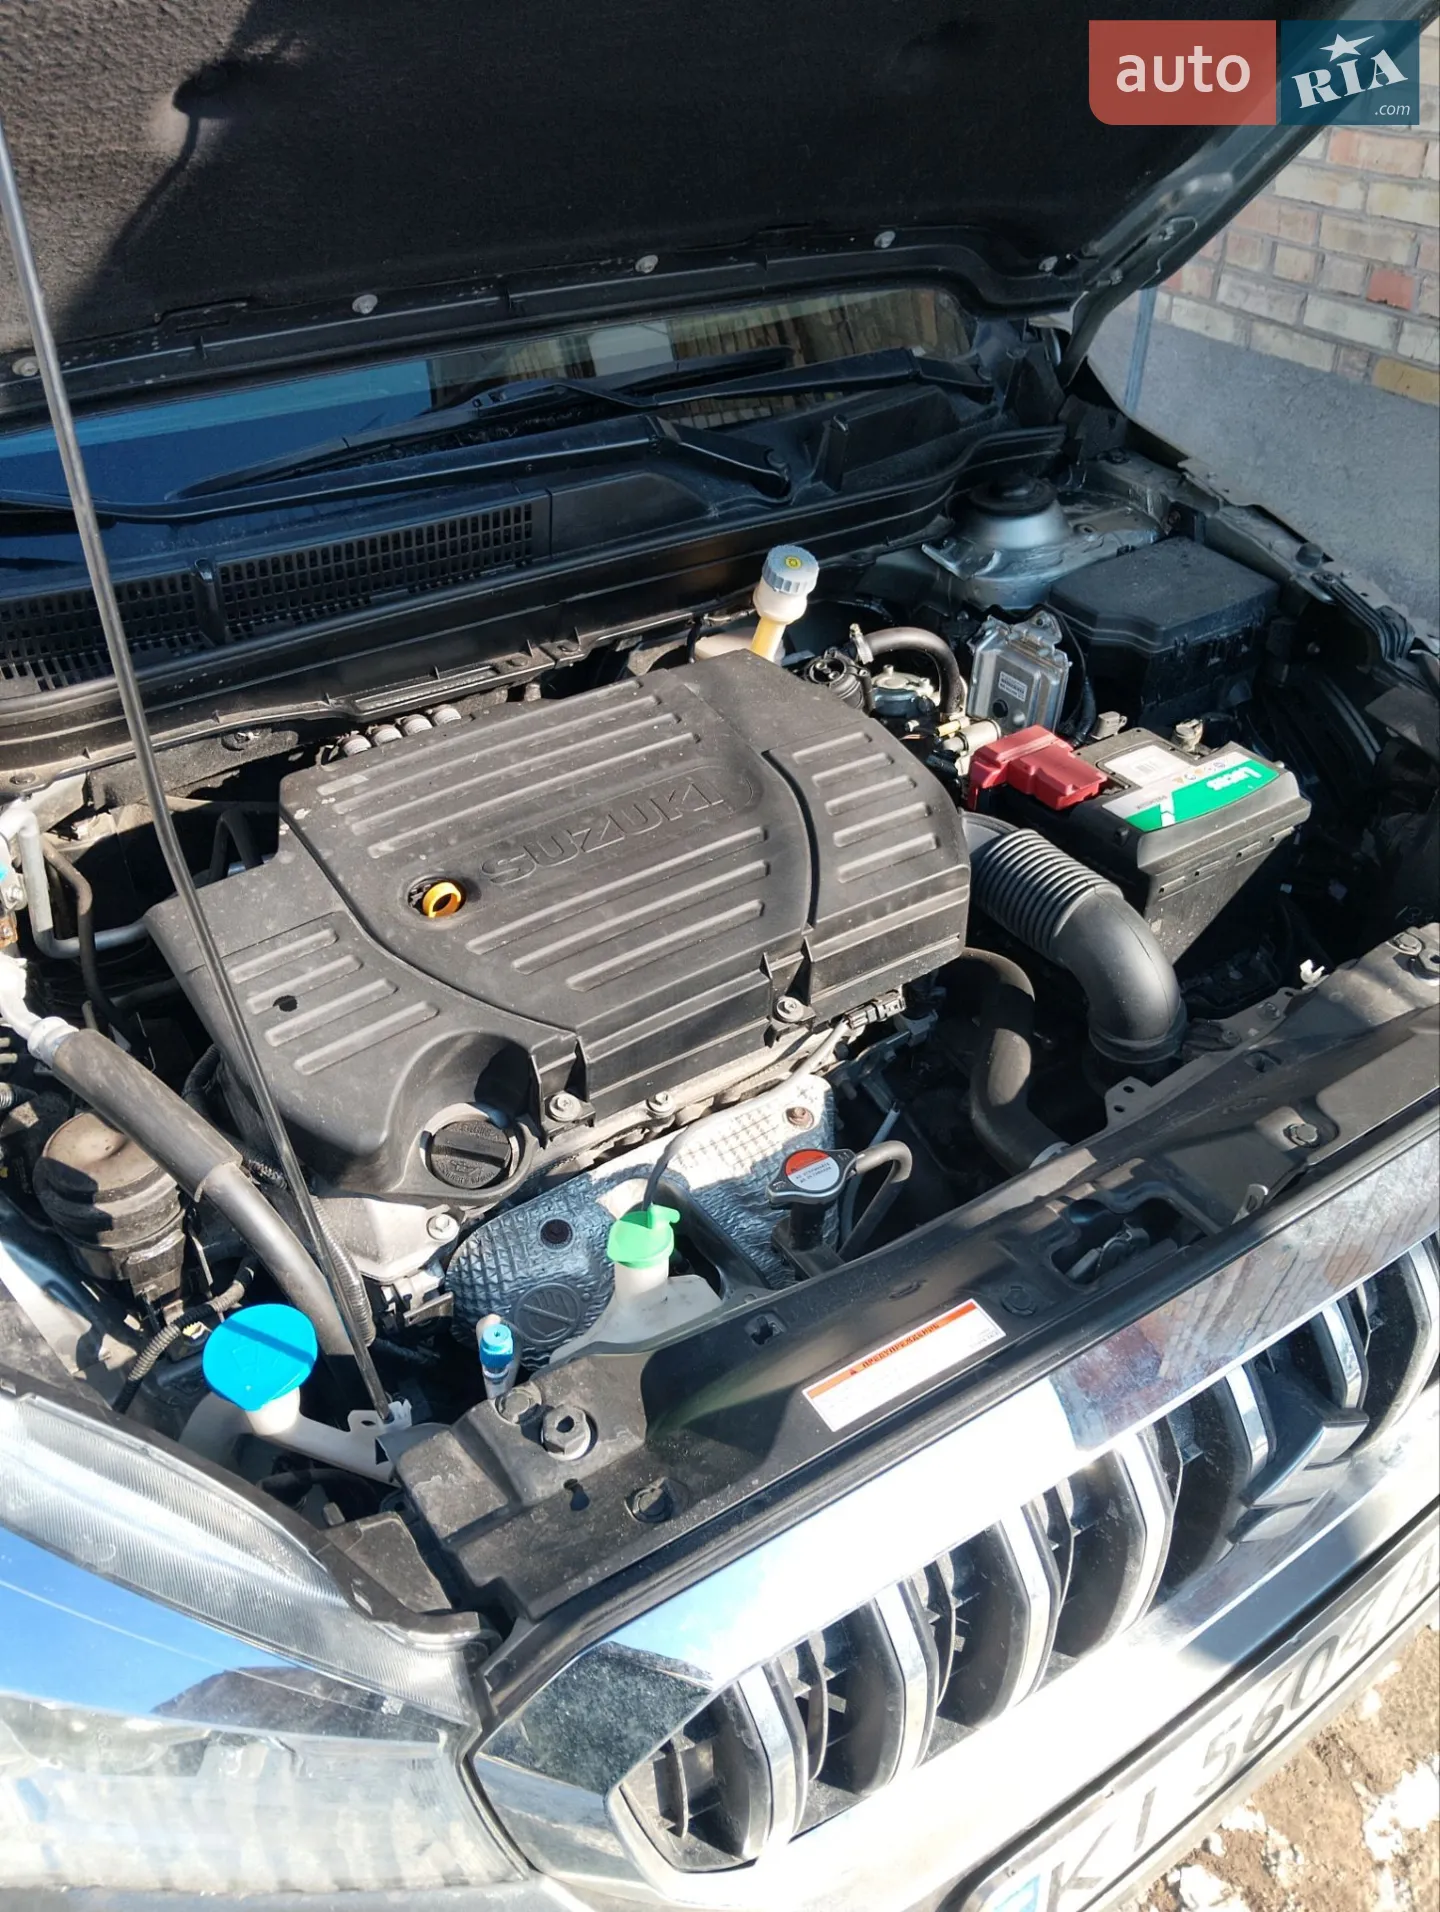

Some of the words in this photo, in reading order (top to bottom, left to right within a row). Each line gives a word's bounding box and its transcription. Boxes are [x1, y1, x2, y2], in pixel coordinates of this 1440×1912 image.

[481, 779, 733, 886] SUZUKI
[1193, 1596, 1377, 1797] 5604
[1386, 1542, 1439, 1626] A
